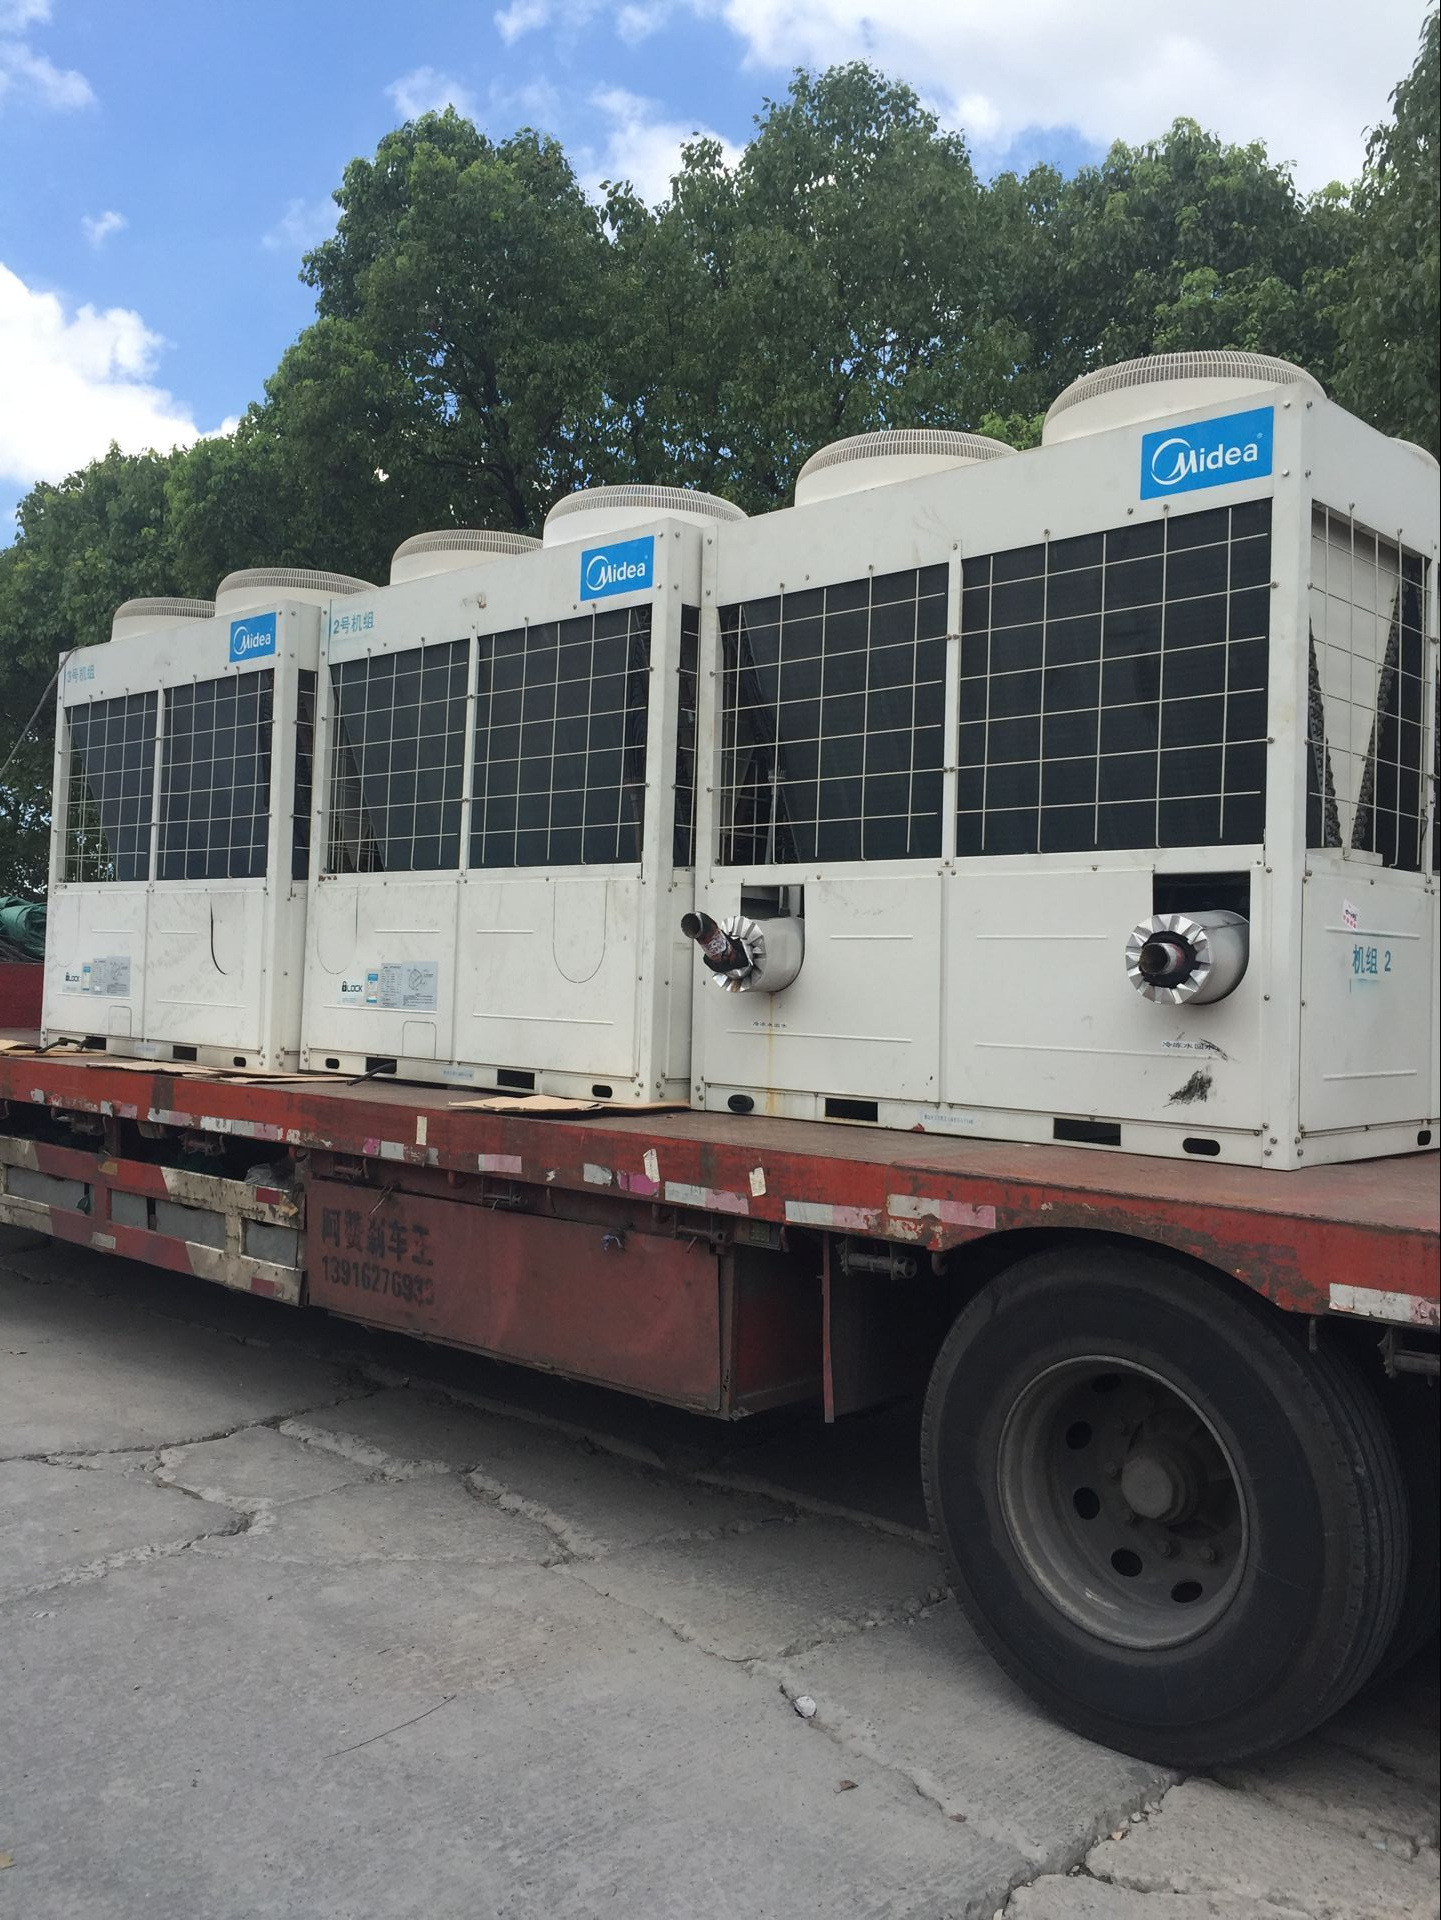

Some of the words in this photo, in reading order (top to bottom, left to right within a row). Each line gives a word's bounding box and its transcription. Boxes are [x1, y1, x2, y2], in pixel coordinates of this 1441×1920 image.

[1151, 438, 1258, 485] Midea
[586, 555, 646, 591] Midea
[333, 611, 374, 635] 2号机组
[234, 626, 272, 654] Midea
[1352, 944, 1378, 974] 机组
[1384, 950, 1392, 972] 2
